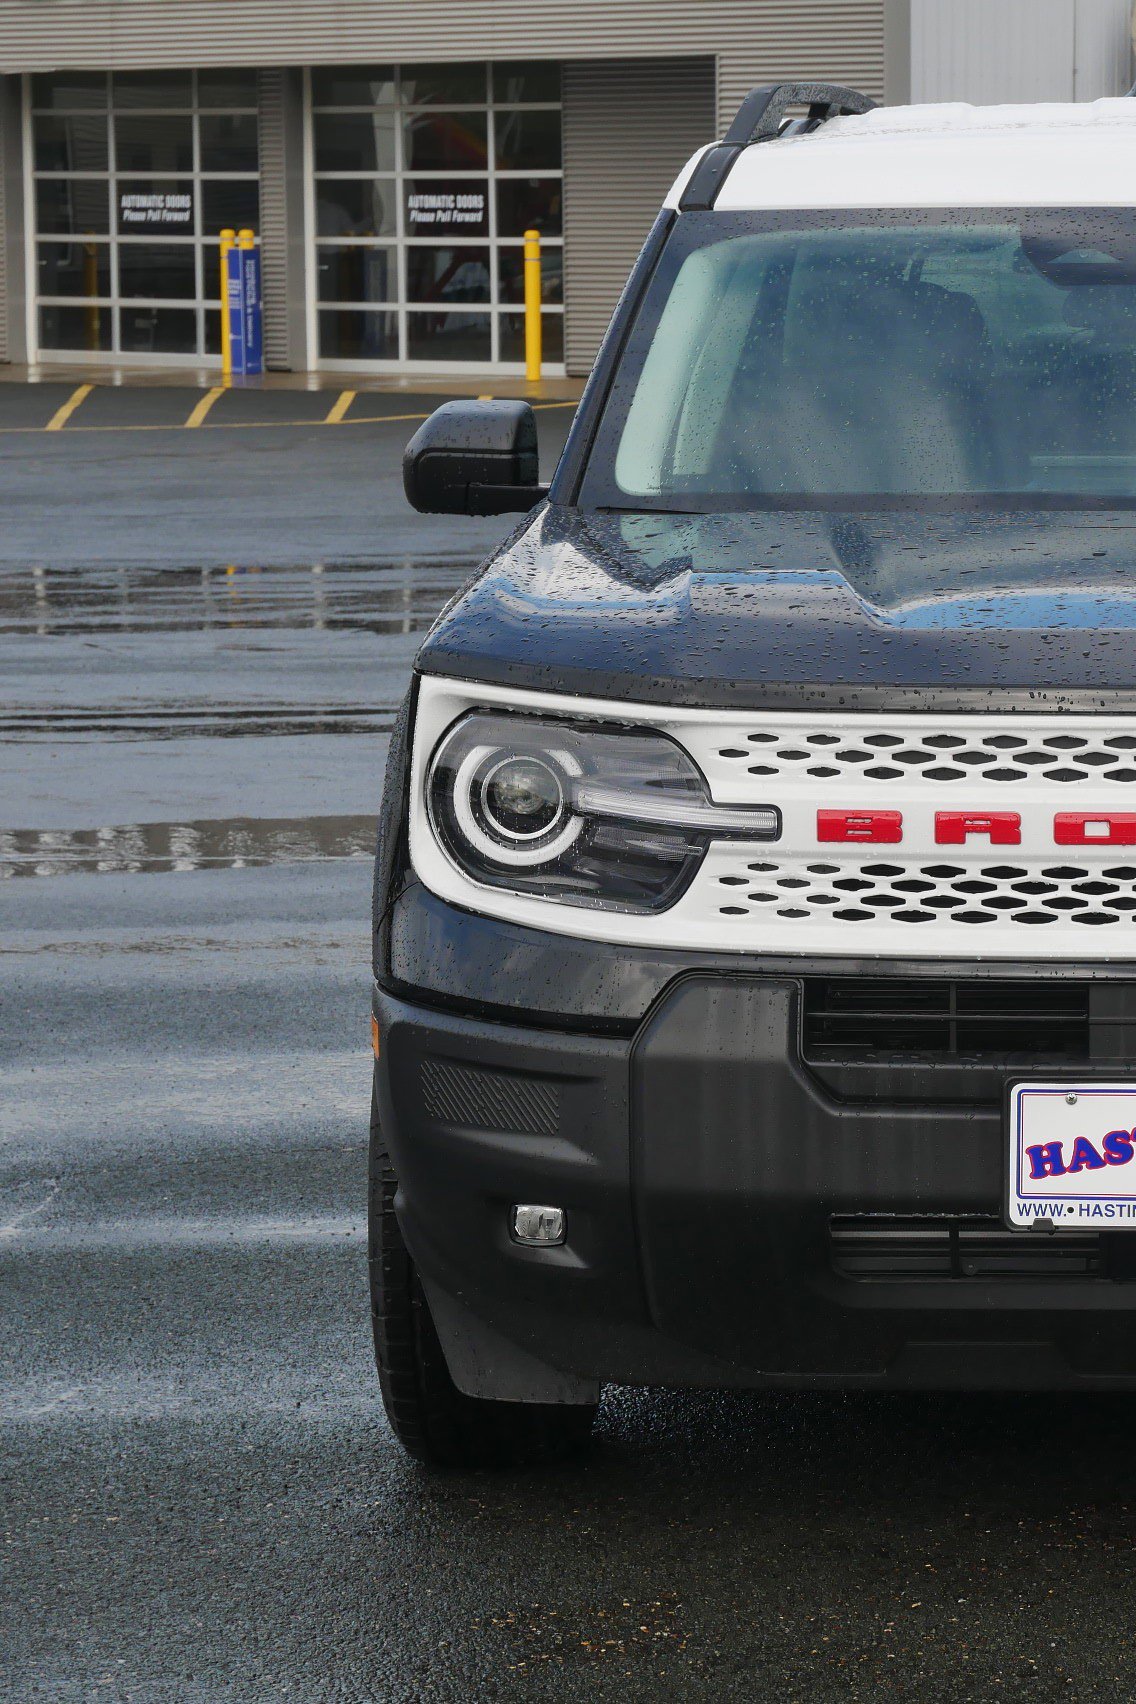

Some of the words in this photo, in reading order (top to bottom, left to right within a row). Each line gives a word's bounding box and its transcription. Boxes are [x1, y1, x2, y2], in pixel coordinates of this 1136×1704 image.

[121, 194, 164, 208] AUTOMATIC
[165, 194, 192, 208] DOORS
[408, 194, 455, 209] AUTOMATIC
[456, 194, 485, 209] DOORS
[122, 208, 147, 222] Please
[147, 209, 162, 222] Pull
[161, 209, 191, 222] Forward
[409, 209, 436, 223] Please
[436, 209, 453, 223] Pull
[452, 209, 484, 223] Forward
